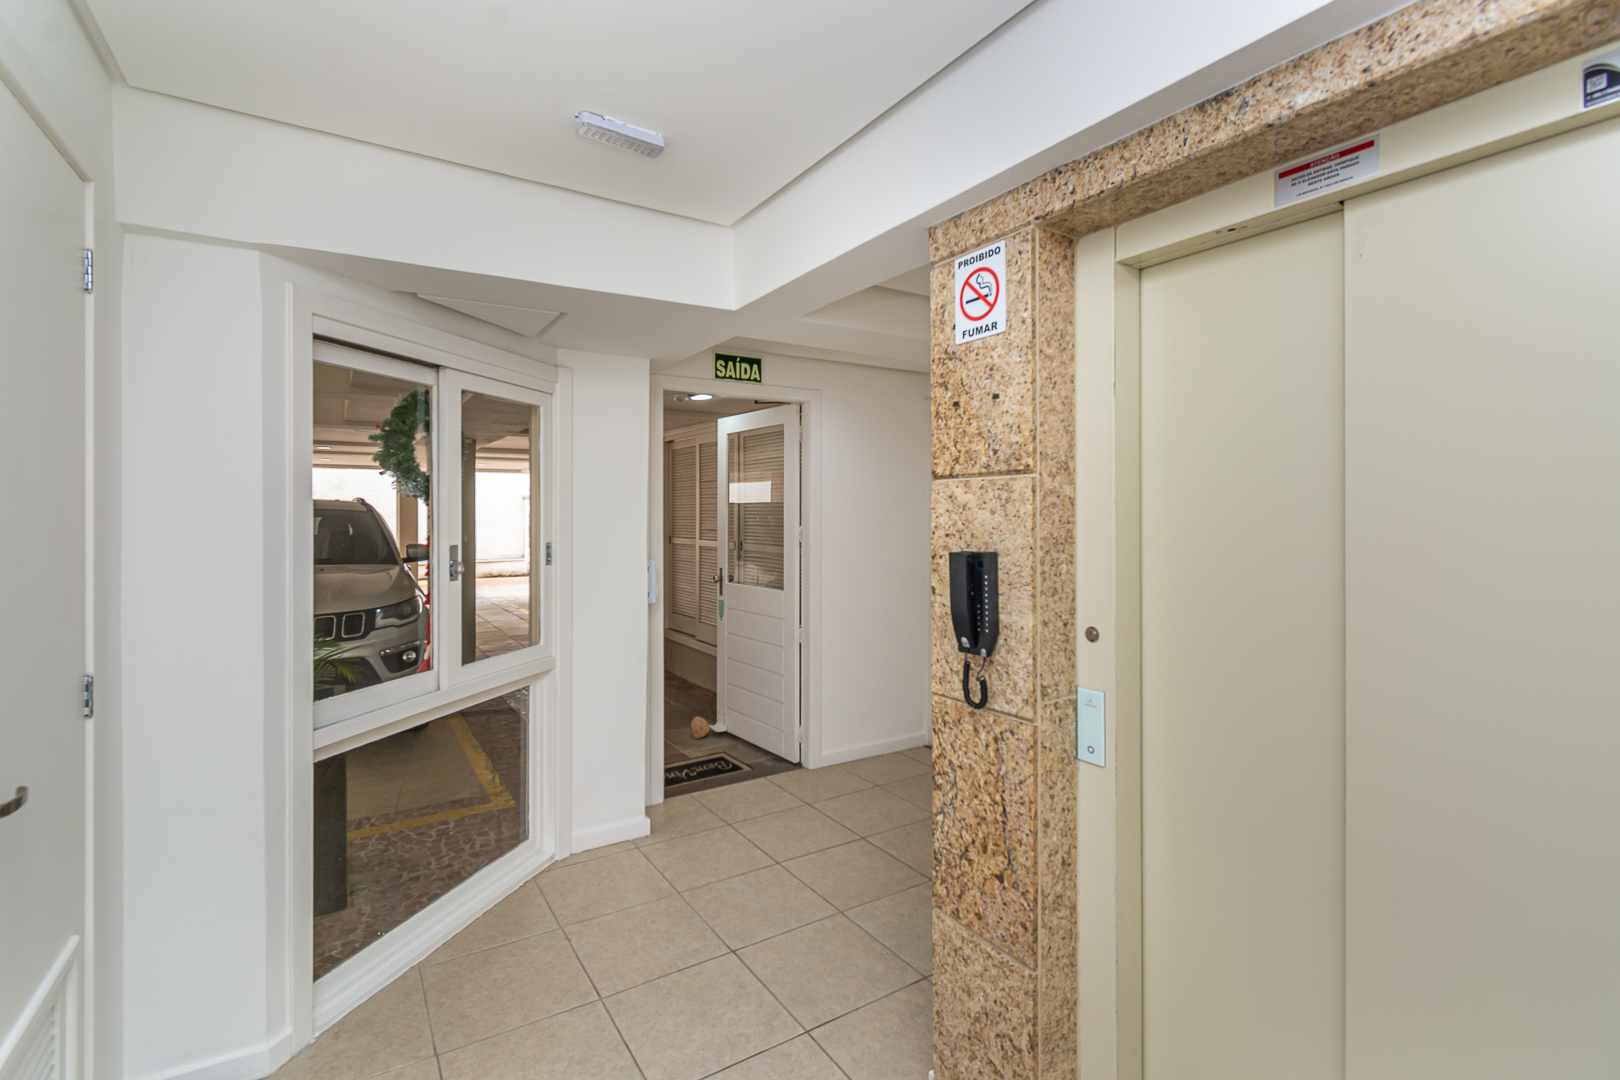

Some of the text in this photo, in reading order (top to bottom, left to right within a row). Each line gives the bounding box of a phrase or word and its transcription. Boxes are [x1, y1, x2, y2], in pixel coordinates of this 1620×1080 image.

[1309, 153, 1340, 168] ATENÇÃO
[958, 246, 1001, 269] PROIBIDO
[962, 322, 998, 339] FUMAR
[716, 357, 760, 381] SAÍDA
